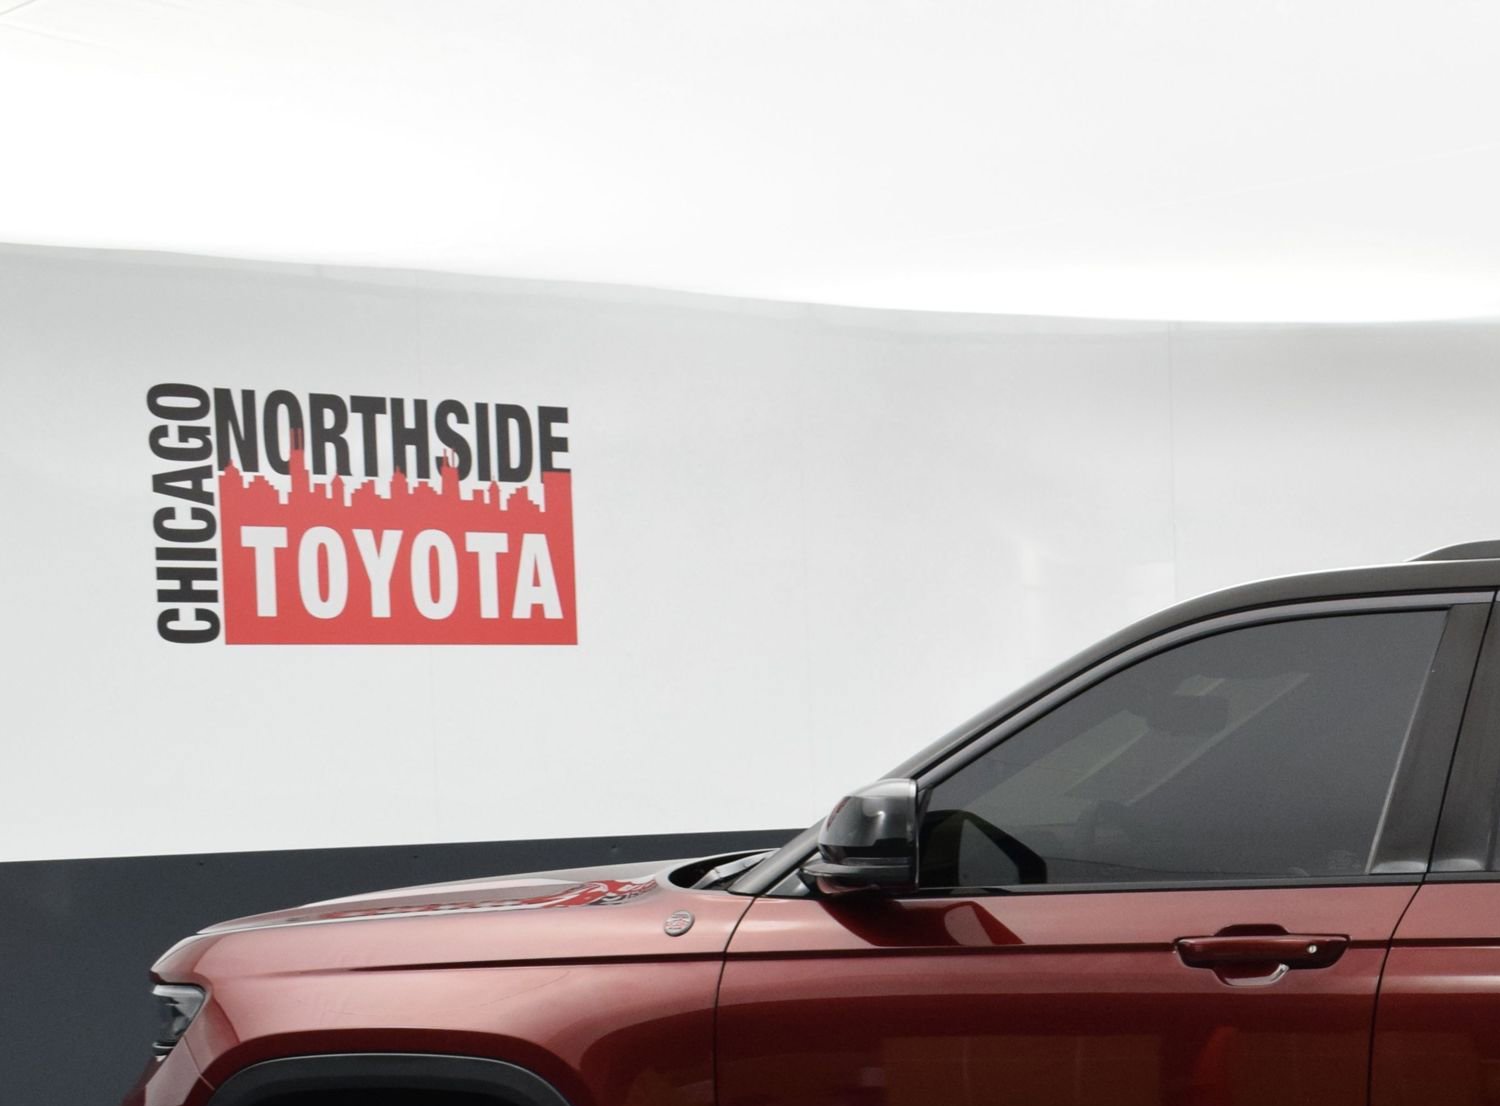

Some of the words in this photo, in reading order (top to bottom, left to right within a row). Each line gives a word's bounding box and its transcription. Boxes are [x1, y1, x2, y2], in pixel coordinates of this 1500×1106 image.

[213, 387, 570, 483] NORTHSIDE
[146, 383, 221, 644] CHICAGO
[240, 525, 564, 620] TOYOTA
